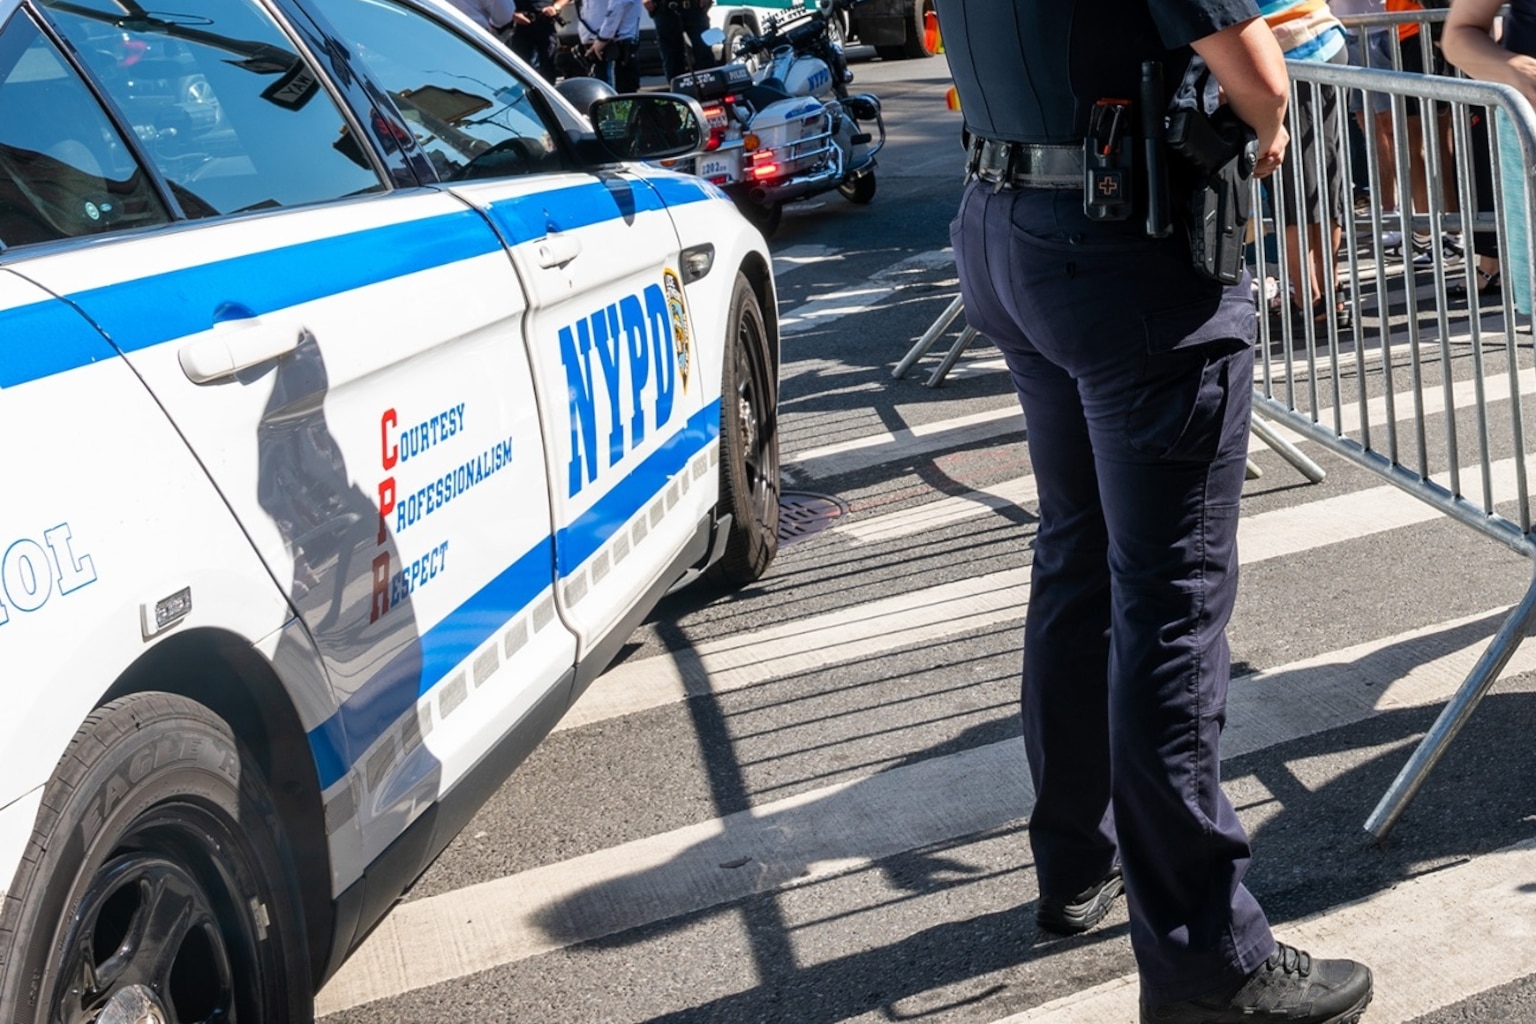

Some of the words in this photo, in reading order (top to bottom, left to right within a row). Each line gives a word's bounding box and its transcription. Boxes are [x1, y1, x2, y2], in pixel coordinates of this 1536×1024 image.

[381, 402, 465, 471] COURTESY
[558, 282, 675, 500] NYPD
[377, 436, 513, 547] PROFESSIONALISM
[369, 540, 449, 625] RESPECT
[81, 737, 202, 853] EAGLE
